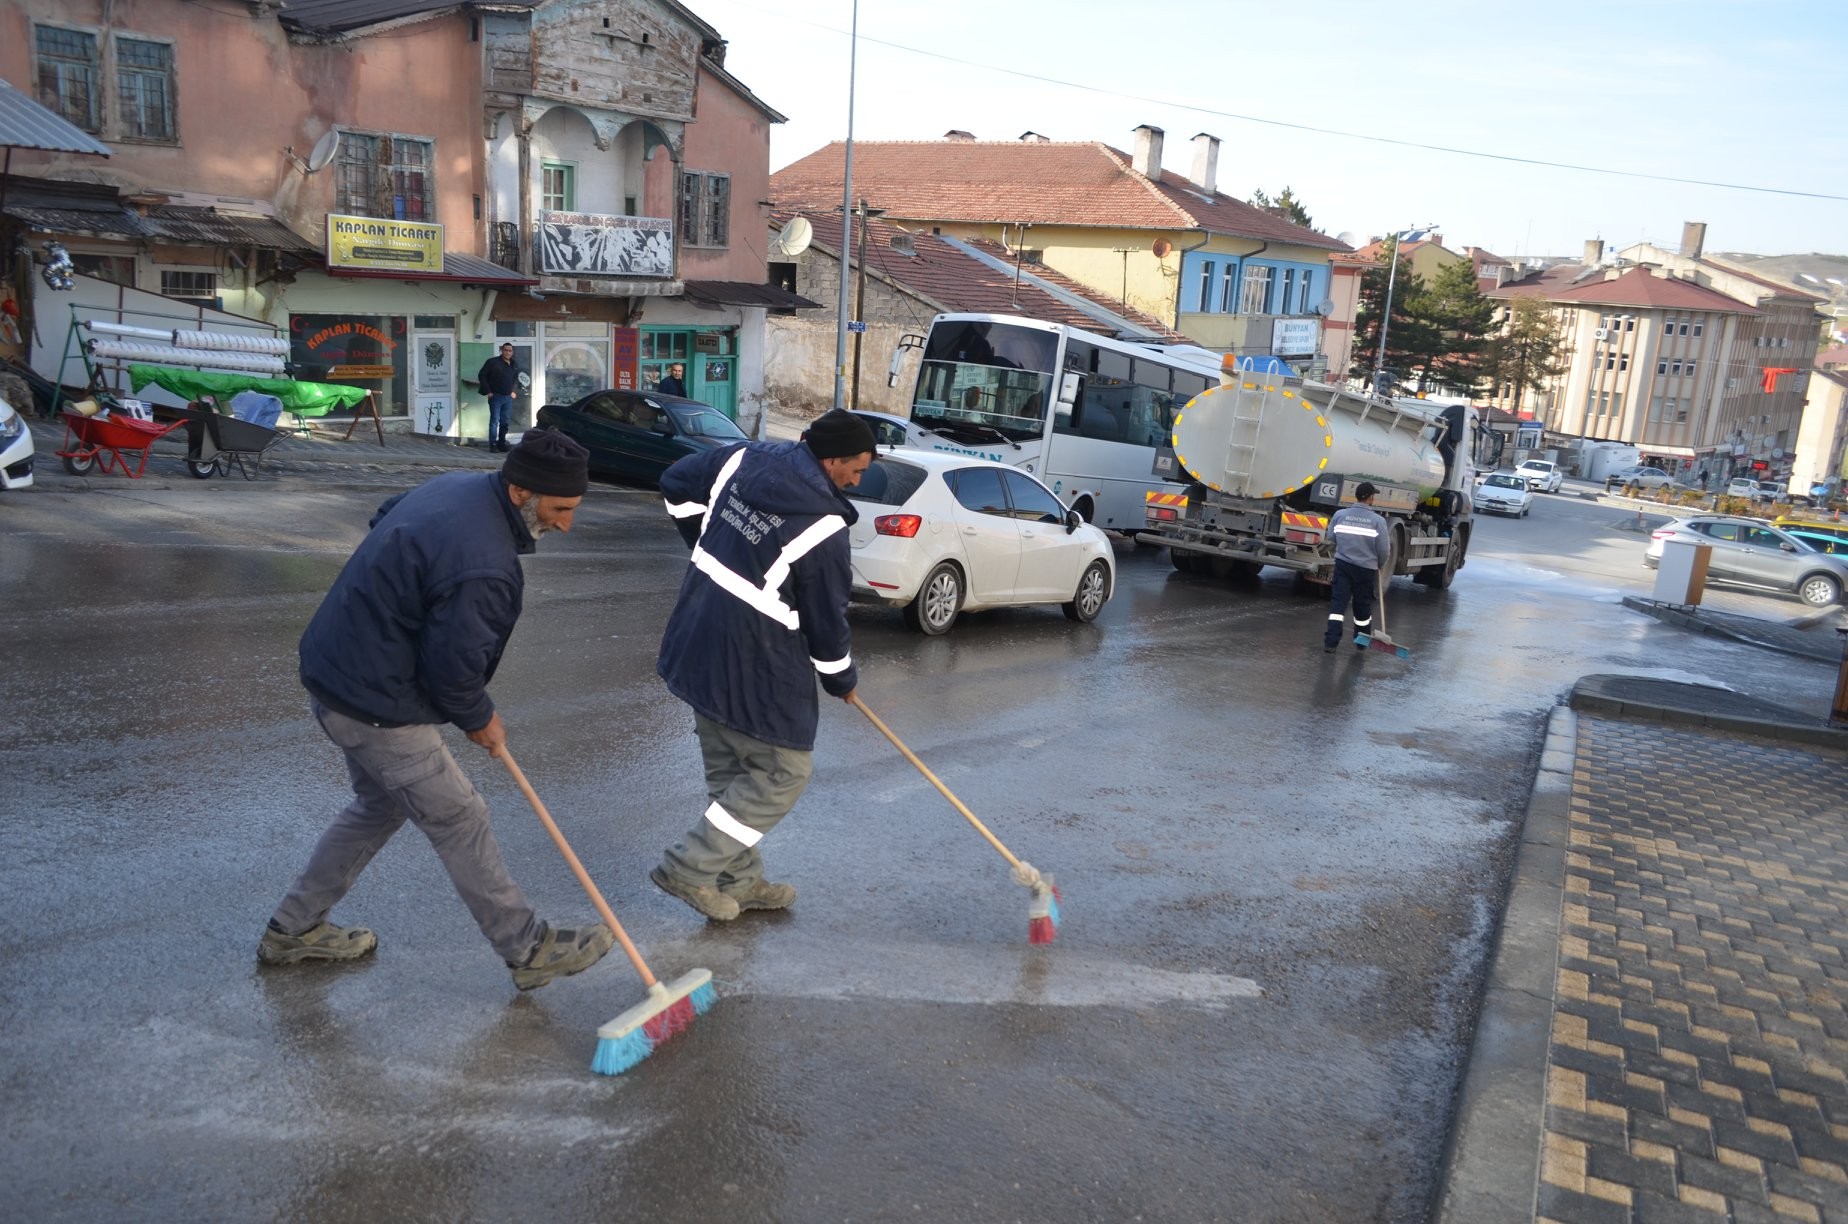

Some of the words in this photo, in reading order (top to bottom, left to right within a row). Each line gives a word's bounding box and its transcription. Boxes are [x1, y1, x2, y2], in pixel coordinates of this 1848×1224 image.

[336, 221, 386, 236] KAPLAN
[390, 224, 437, 240] TİCARET
[306, 322, 351, 350] KAPLAN
[354, 321, 398, 351] TİCARET
[727, 495, 752, 517] TEMİZLİK
[720, 508, 762, 545] MÜDÜRLÜĞÜ
[748, 511, 772, 535] İŞLERİ
